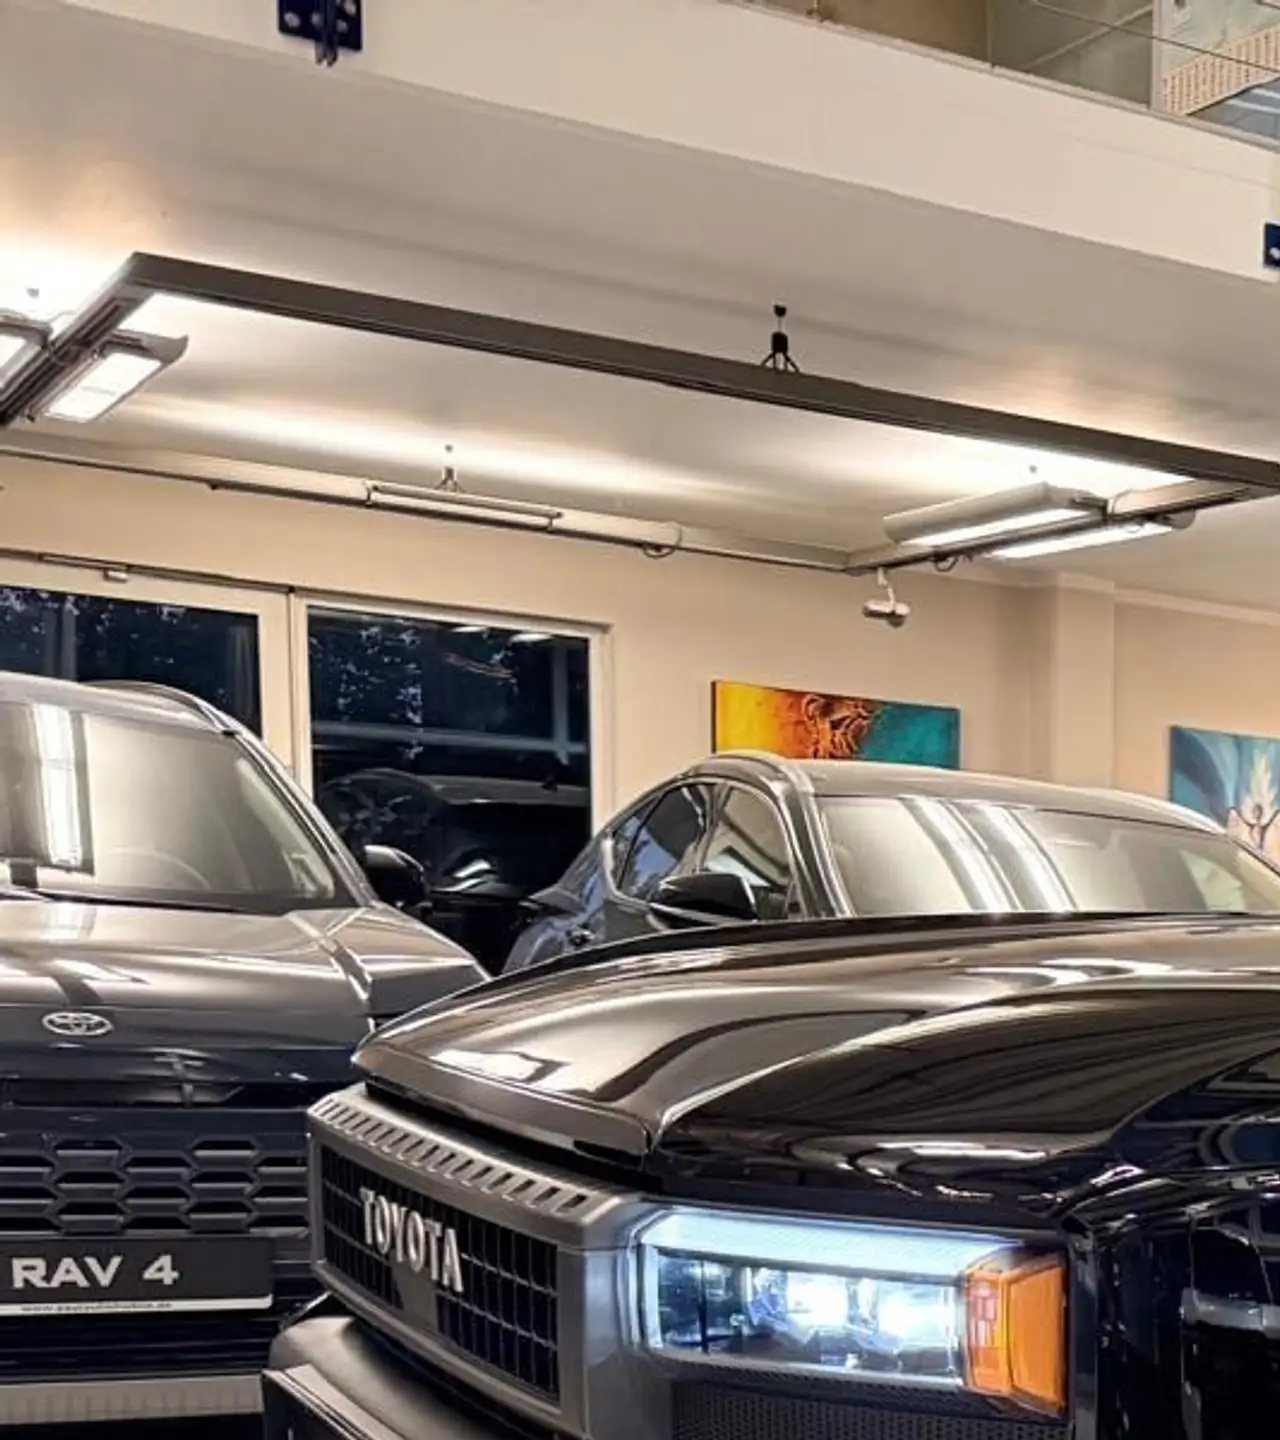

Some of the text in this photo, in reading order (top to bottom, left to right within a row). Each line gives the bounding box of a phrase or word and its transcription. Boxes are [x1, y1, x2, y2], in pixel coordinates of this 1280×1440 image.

[11, 1253, 181, 1289] RAV 4
[360, 1187, 464, 1293] TOYOTA
